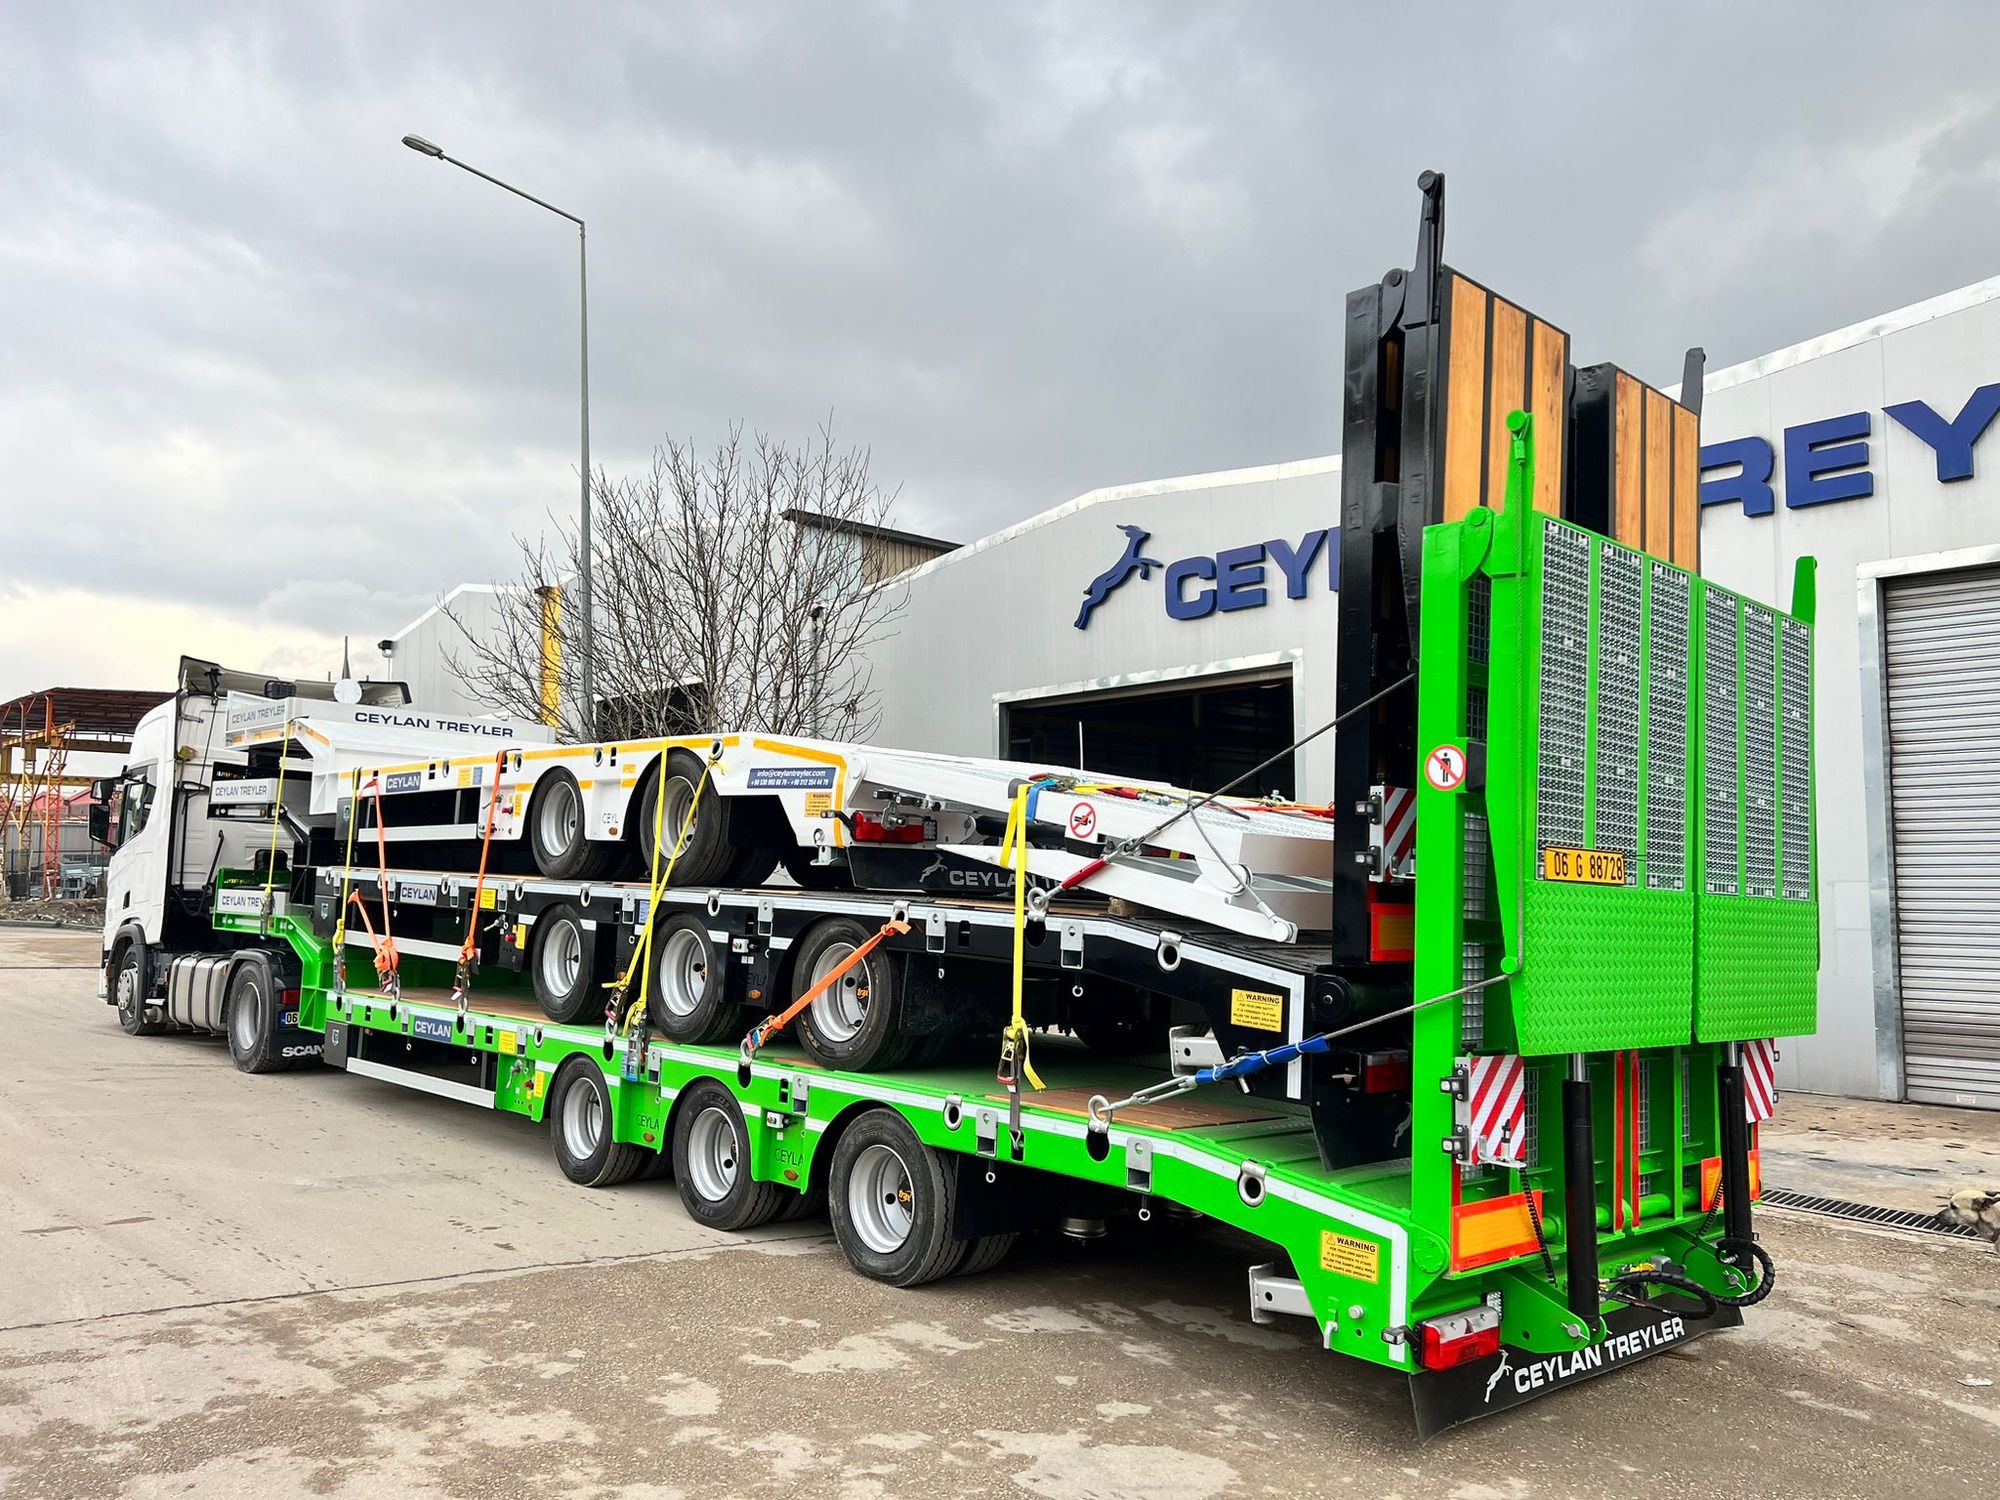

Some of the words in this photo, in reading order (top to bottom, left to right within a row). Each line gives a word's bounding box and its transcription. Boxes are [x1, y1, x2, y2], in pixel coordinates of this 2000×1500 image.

[231, 710, 257, 724] CEYLAN
[257, 705, 285, 718] TREYLER
[355, 712, 430, 729] CEYLAN
[436, 720, 514, 738] TREYLER
[387, 775, 420, 789] CEYLAN
[215, 786, 239, 797] CEYLAN
[240, 785, 268, 796] TREYLER
[1554, 851, 1568, 877] 06
[1576, 853, 1583, 878] G
[1590, 855, 1623, 881] 88728
[222, 895, 246, 907] CEYLAN
[401, 887, 436, 901] CEYLAN
[1245, 993, 1280, 1005] WARNING
[286, 1013, 298, 1023] 06
[415, 1020, 451, 1038] CEYLAN
[1336, 1236, 1376, 1253] WARNING
[1514, 1344, 1603, 1394] CEYLAN
[1604, 1316, 1686, 1362] TREYLER
